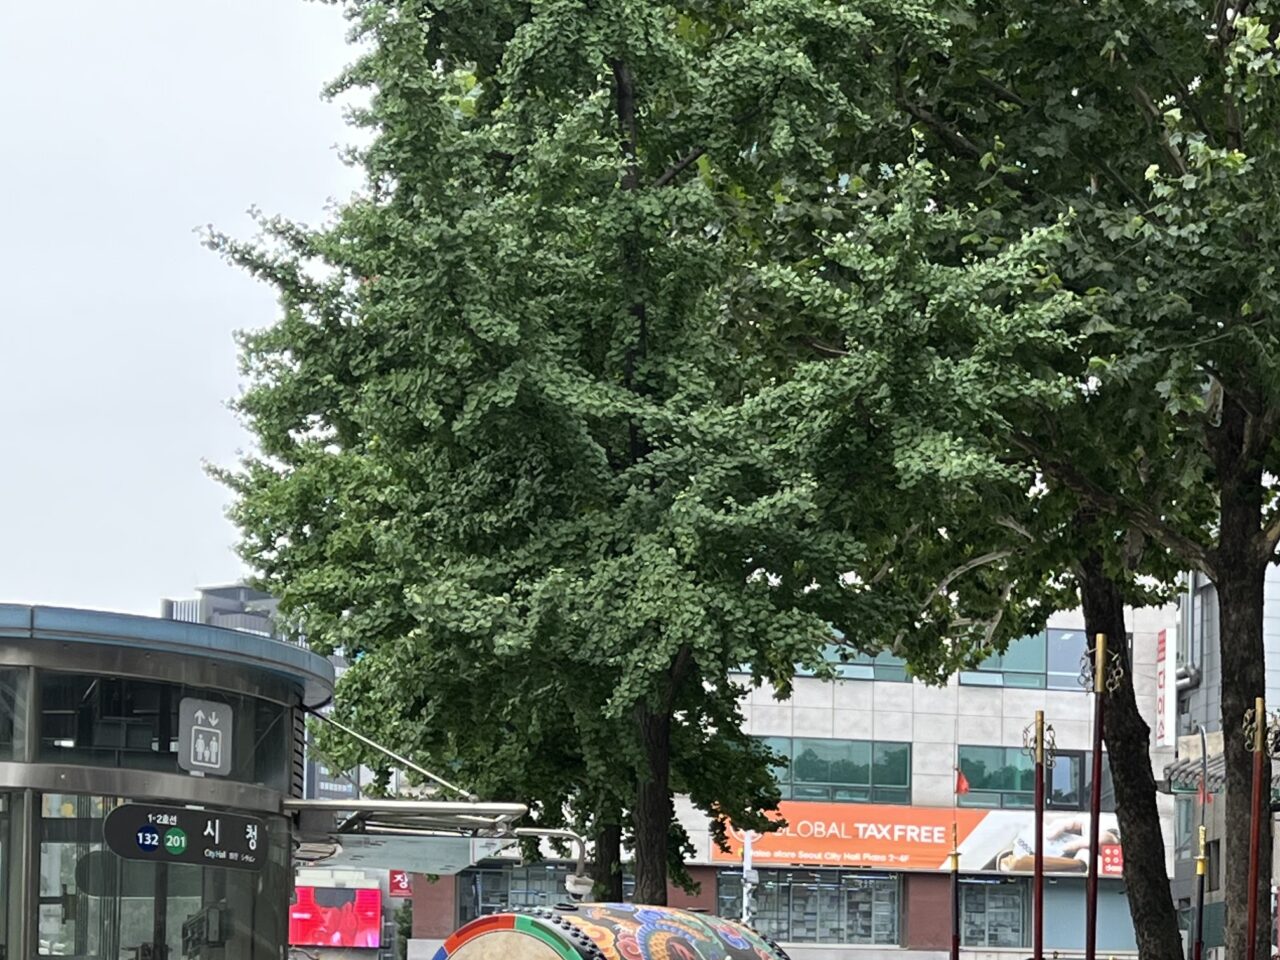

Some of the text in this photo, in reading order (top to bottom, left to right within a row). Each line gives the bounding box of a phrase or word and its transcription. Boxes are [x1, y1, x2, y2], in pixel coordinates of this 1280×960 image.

[137, 832, 186, 848] 132 201
[854, 822, 892, 841] TAX
[893, 824, 946, 844] FREE
[750, 849, 772, 858] aiso
[797, 850, 822, 860] Seoul
[823, 851, 842, 862] City
